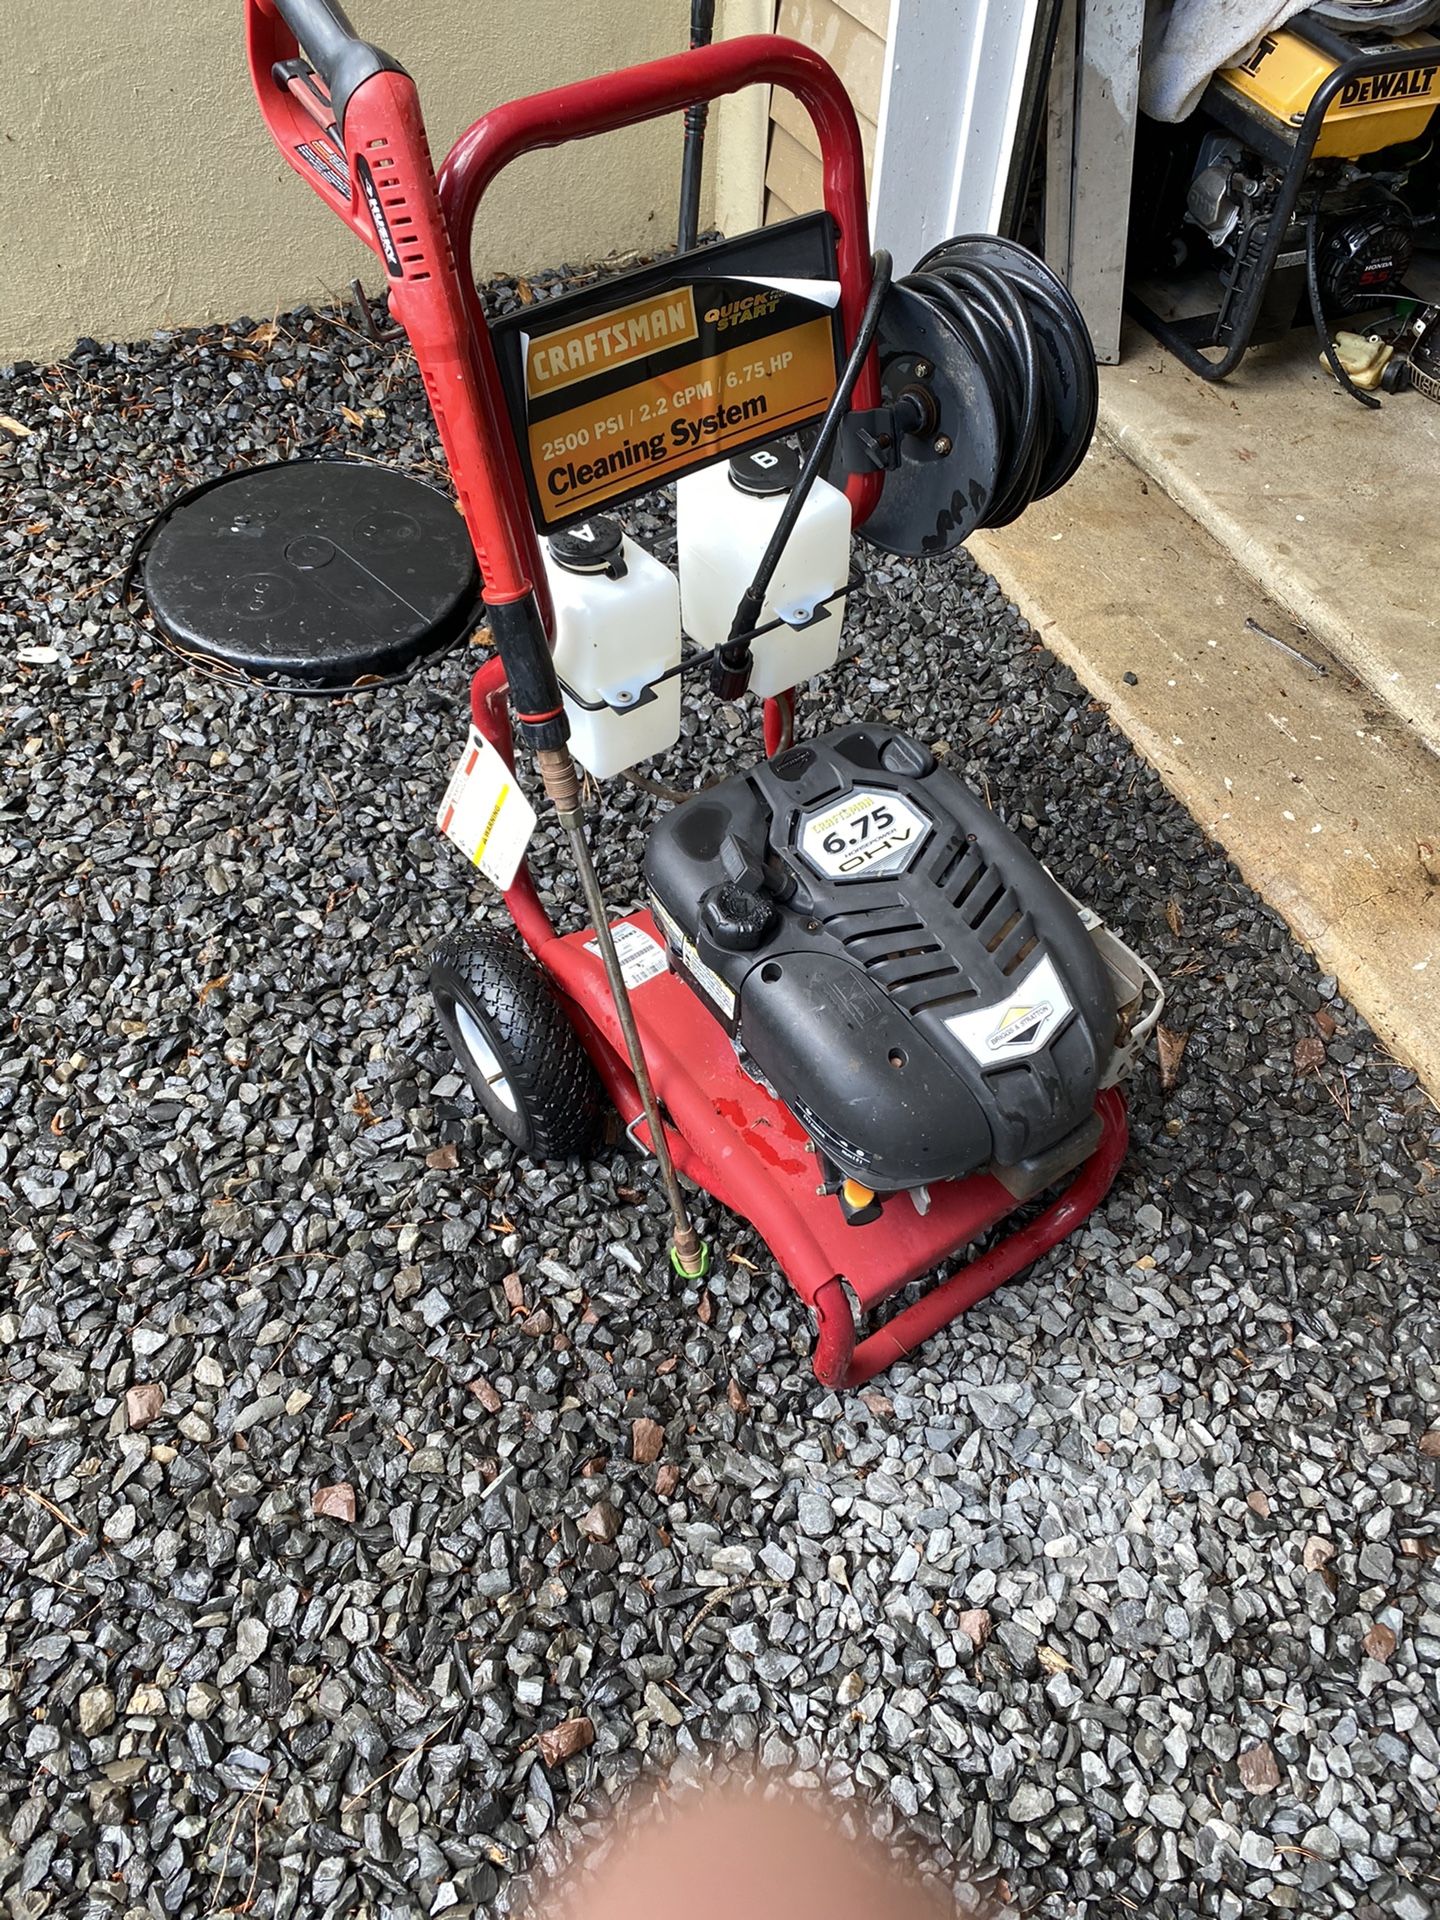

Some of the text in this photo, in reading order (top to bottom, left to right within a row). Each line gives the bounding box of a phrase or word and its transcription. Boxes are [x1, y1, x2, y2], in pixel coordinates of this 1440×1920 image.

[1364, 261, 1393, 272] HONDA
[704, 291, 770, 323] QUICK
[717, 300, 779, 331] START
[532, 302, 686, 381] CRAFTSMAN
[542, 428, 590, 461] 2500
[594, 413, 624, 440] PSI
[639, 397, 668, 422] 2.2
[672, 380, 713, 408] GPM
[726, 361, 765, 388] 6.75
[769, 351, 793, 373] HP
[547, 394, 767, 496] Cleaning System
[750, 450, 779, 469] B
[567, 523, 596, 542] A
[485, 805, 501, 837] WARNING
[812, 796, 875, 834] CRAFTSMAN
[822, 805, 894, 854] 6.75
[838, 827, 911, 872] OHV
[844, 828, 897, 858] HORSEPOWER
[990, 1026, 1015, 1045] BRIGGS
[1020, 1006, 1049, 1028] STRATTON
